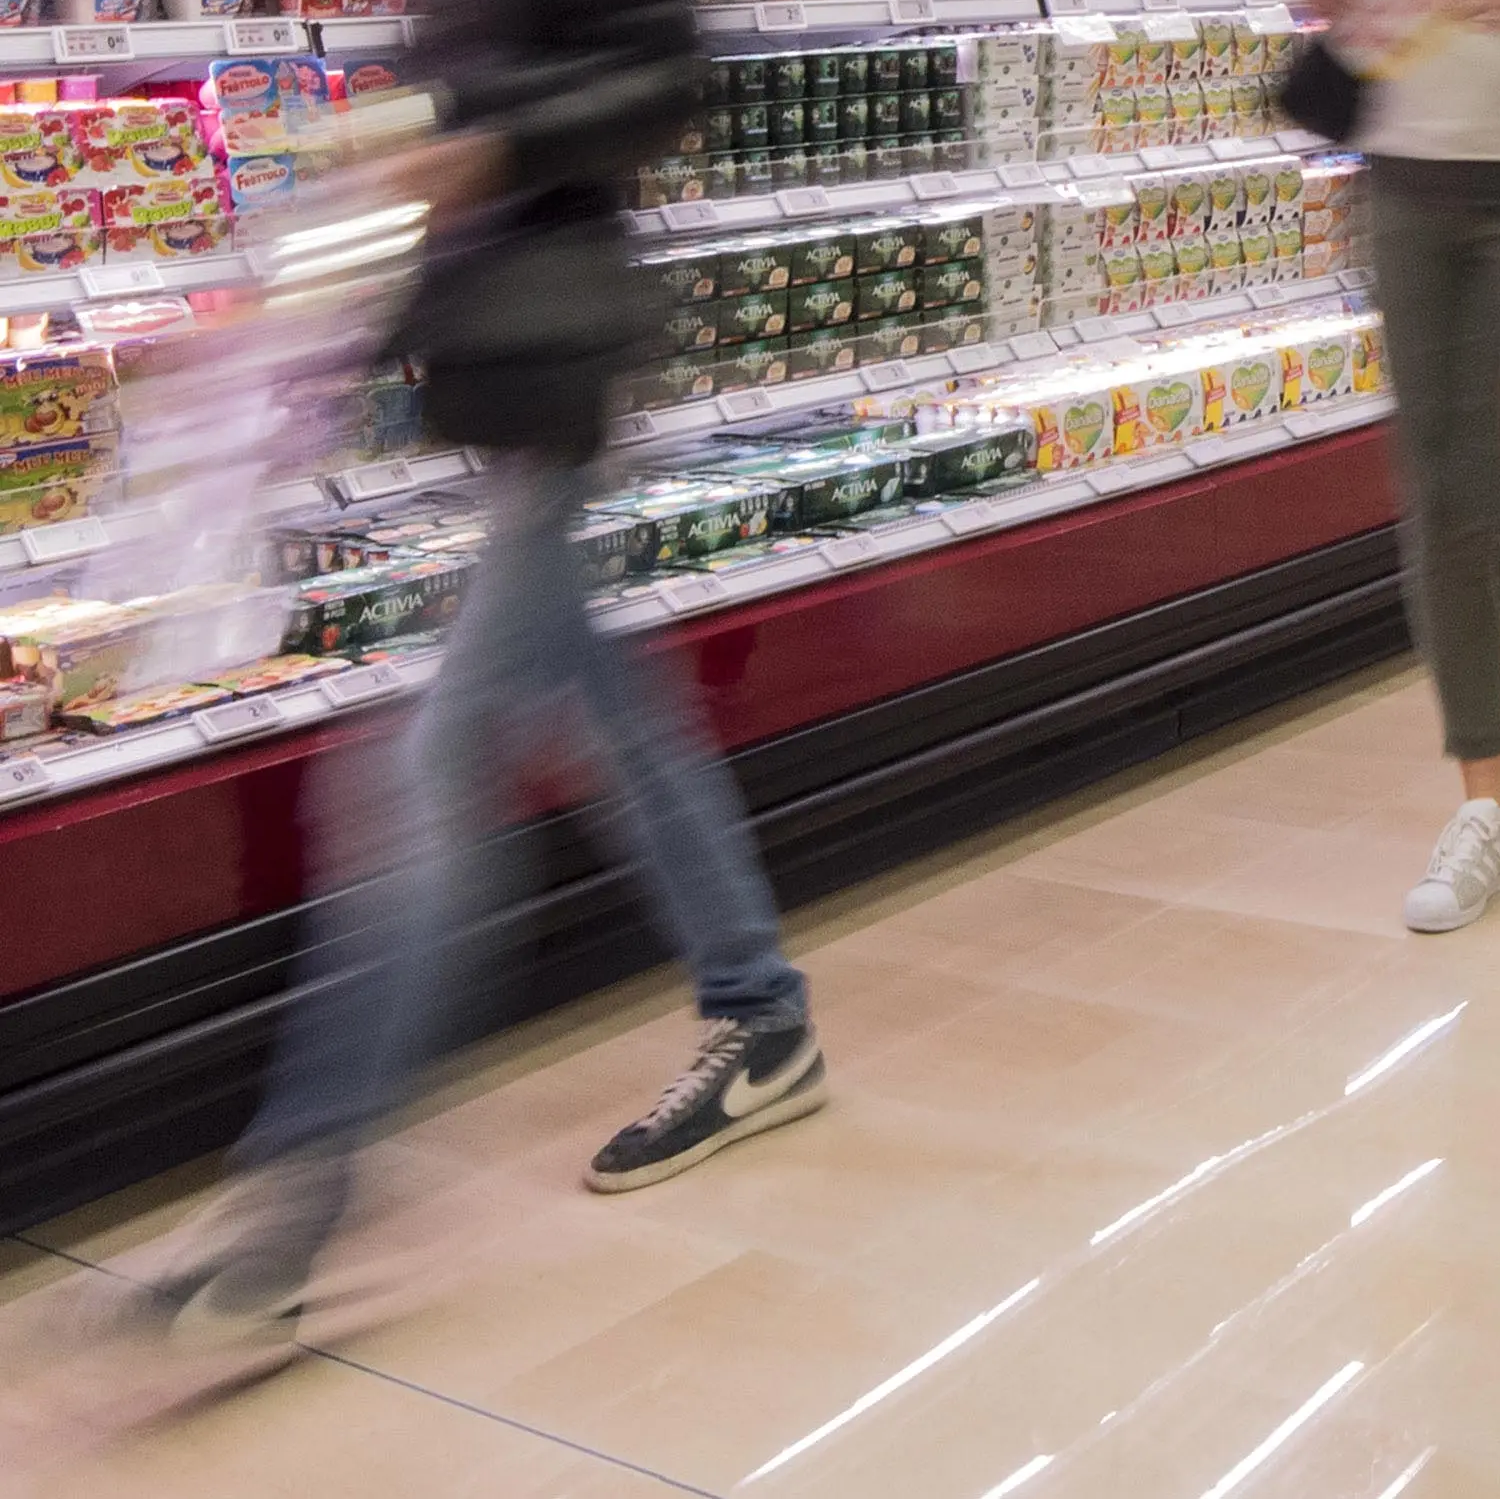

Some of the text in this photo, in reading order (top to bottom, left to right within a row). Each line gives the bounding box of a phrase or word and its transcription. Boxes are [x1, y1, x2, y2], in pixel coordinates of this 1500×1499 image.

[737, 256, 777, 273] ACTIVIA
[961, 447, 1003, 470] ACTIVIA
[831, 479, 878, 502] ACTIVIA
[687, 511, 741, 539] ACTIVIA
[359, 592, 424, 624] ACTIVIA
